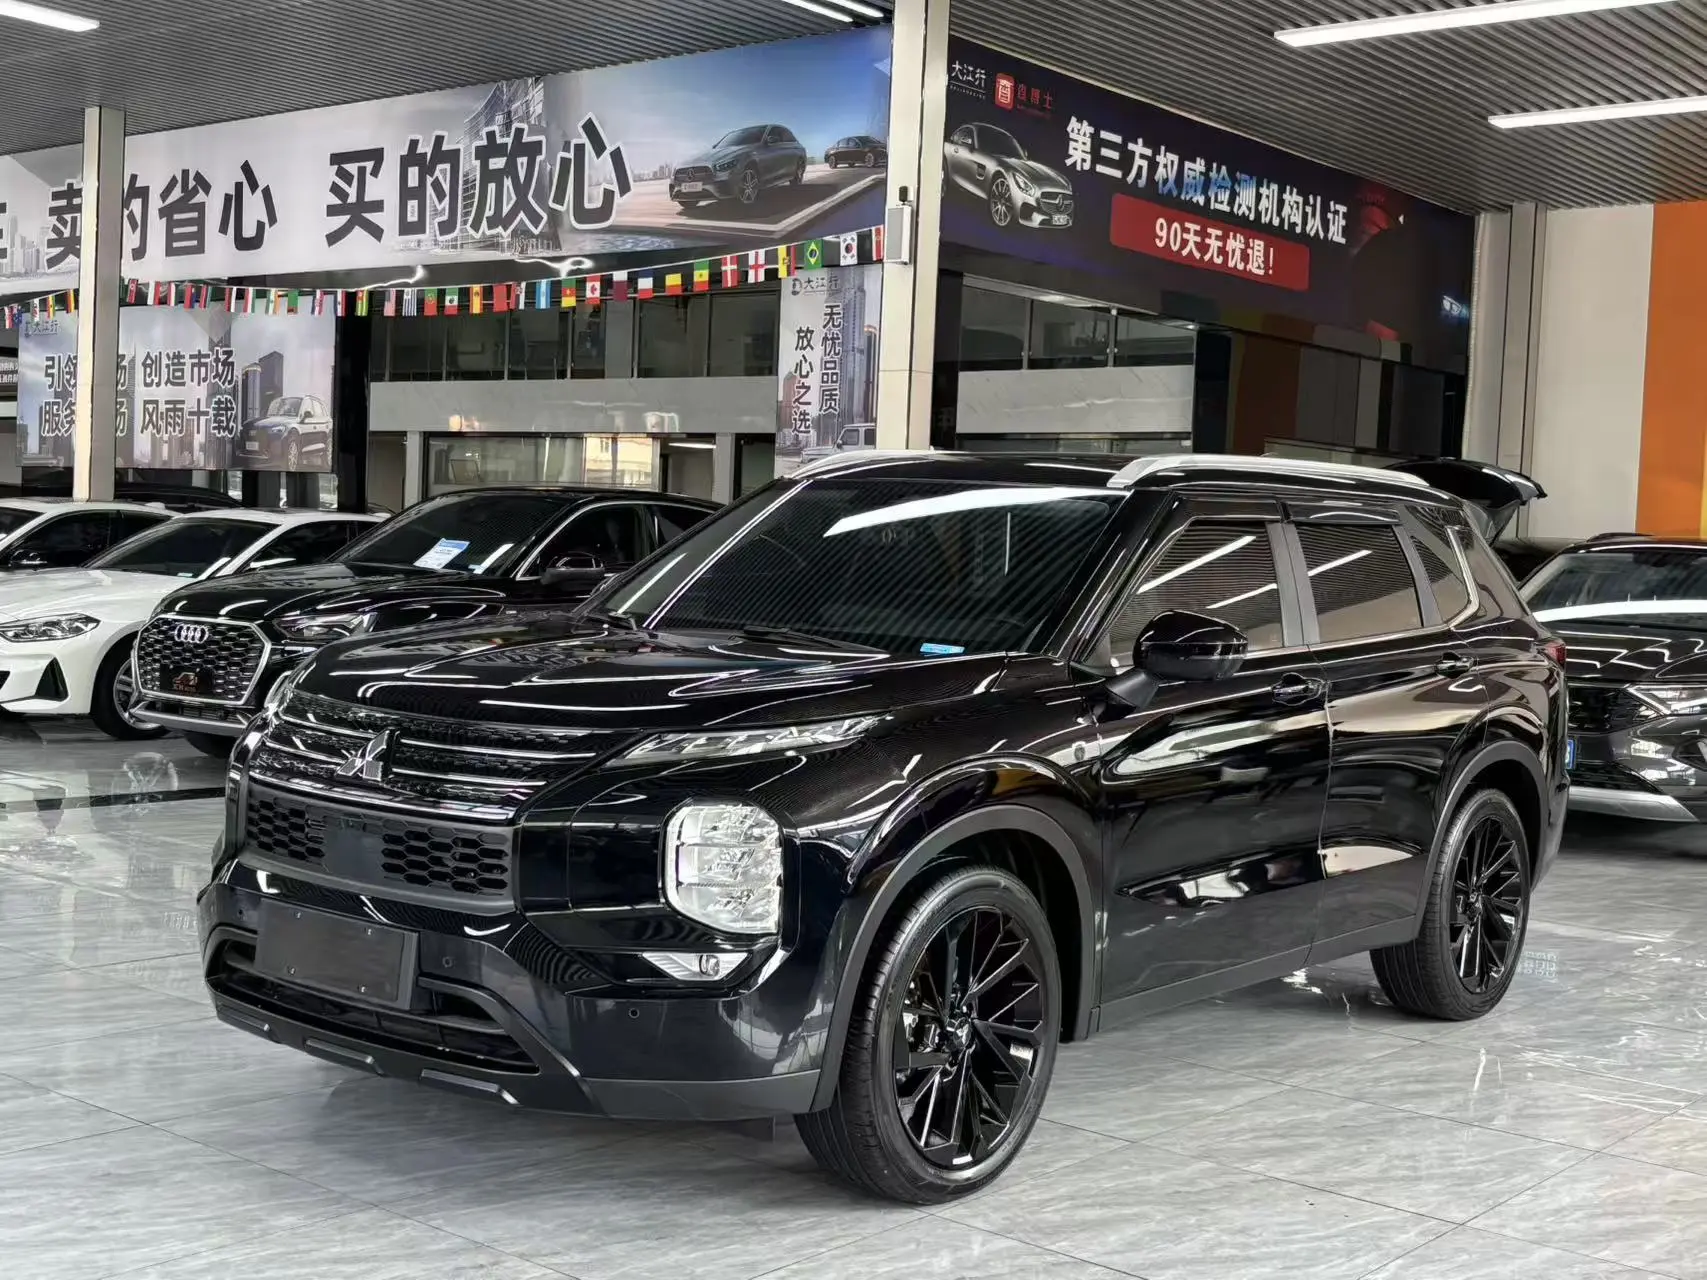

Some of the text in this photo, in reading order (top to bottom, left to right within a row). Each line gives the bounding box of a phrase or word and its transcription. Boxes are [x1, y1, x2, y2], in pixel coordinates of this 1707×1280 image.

[951, 61, 986, 87] 大江行
[324, 114, 632, 248] 买的放心
[1064, 115, 1348, 245] 第三方权威检测机构认证
[804, 273, 840, 290] 大江行
[141, 347, 236, 389] 创造市场
[791, 326, 815, 435] 放心之选
[819, 304, 843, 414] 无忧品质
[140, 395, 237, 438] 风雨十载
